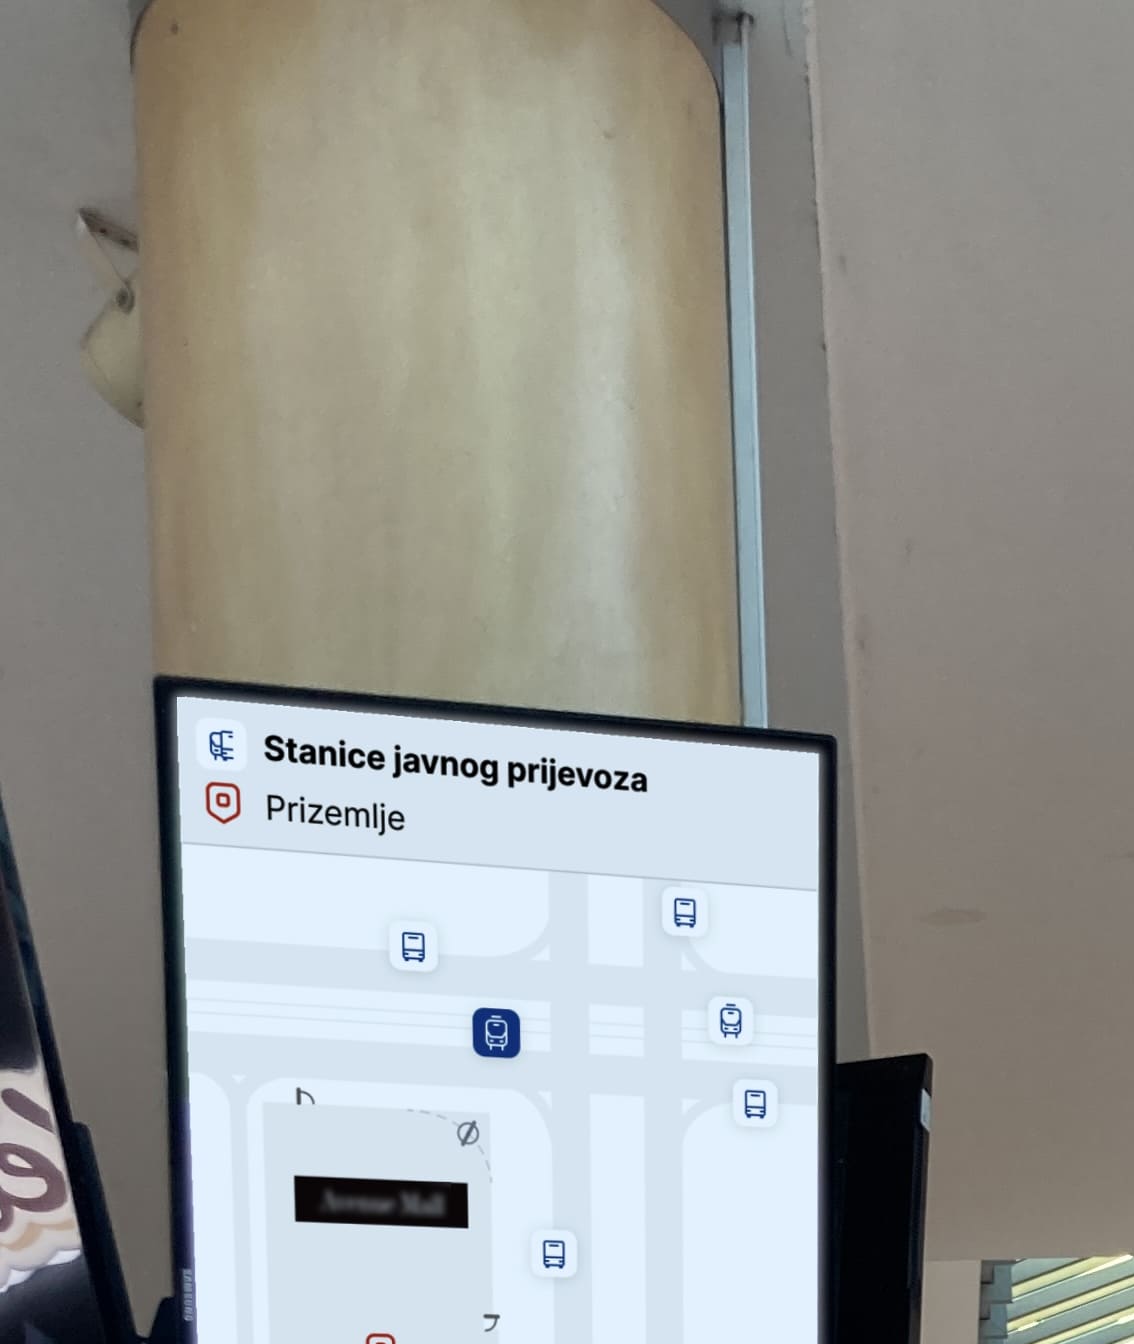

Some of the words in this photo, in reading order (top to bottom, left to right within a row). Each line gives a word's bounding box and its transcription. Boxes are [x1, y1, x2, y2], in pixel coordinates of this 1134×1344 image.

[263, 734, 386, 771] Stanice
[392, 744, 499, 787] javnog
[507, 756, 648, 793] prijevoza
[266, 794, 406, 837] Prizemlje
